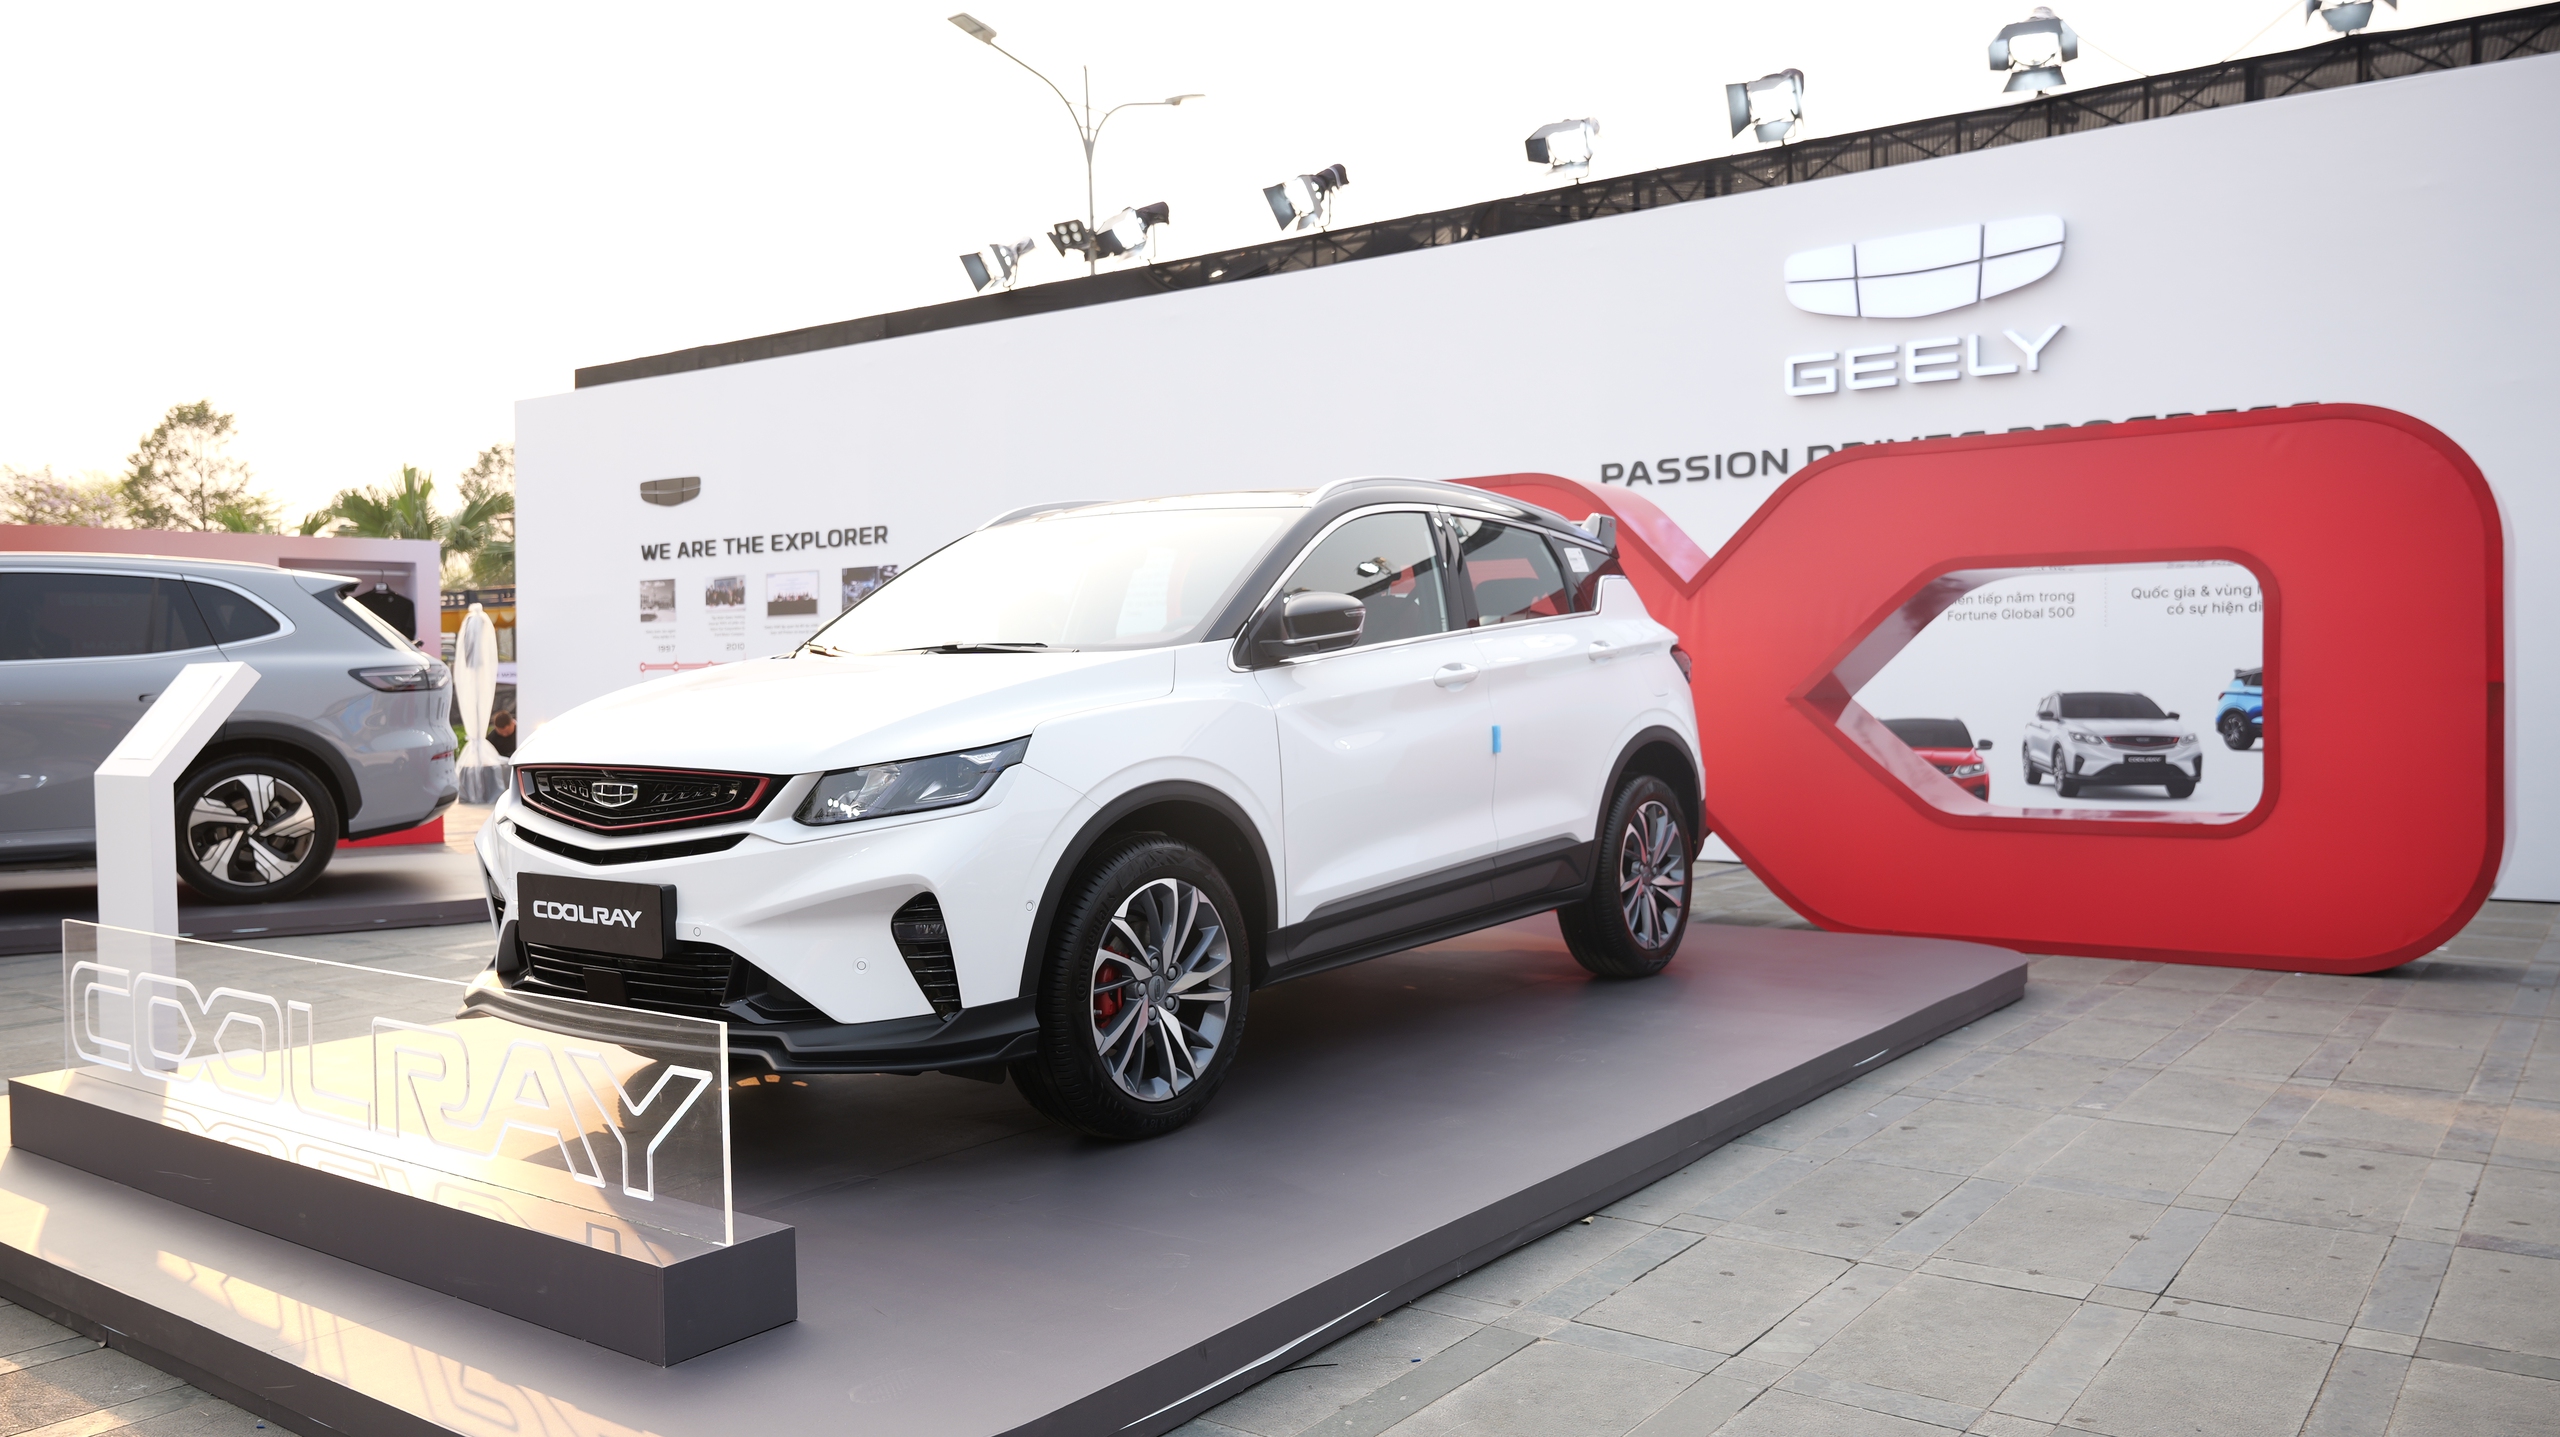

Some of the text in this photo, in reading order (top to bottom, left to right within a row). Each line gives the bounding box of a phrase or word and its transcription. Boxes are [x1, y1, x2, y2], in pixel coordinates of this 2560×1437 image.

[1784, 324, 2066, 397] GEELY
[1600, 447, 1788, 486] PASSION
[641, 525, 889, 561] WE ARE THE EXPLORER
[2039, 591, 2075, 605] trong
[2131, 585, 2169, 600] Quốc
[2174, 586, 2196, 600] gia
[2200, 586, 2210, 597] &
[2215, 584, 2252, 599] vùng
[1947, 607, 2075, 622] Fortune Global 500
[2166, 601, 2184, 615] có
[2189, 604, 2208, 617] sự
[2212, 601, 2244, 617] hiện
[658, 644, 676, 654] 1997
[726, 642, 745, 652] 2010
[533, 900, 642, 928] COOLRAY
[70, 960, 714, 1202] COOLRAY
